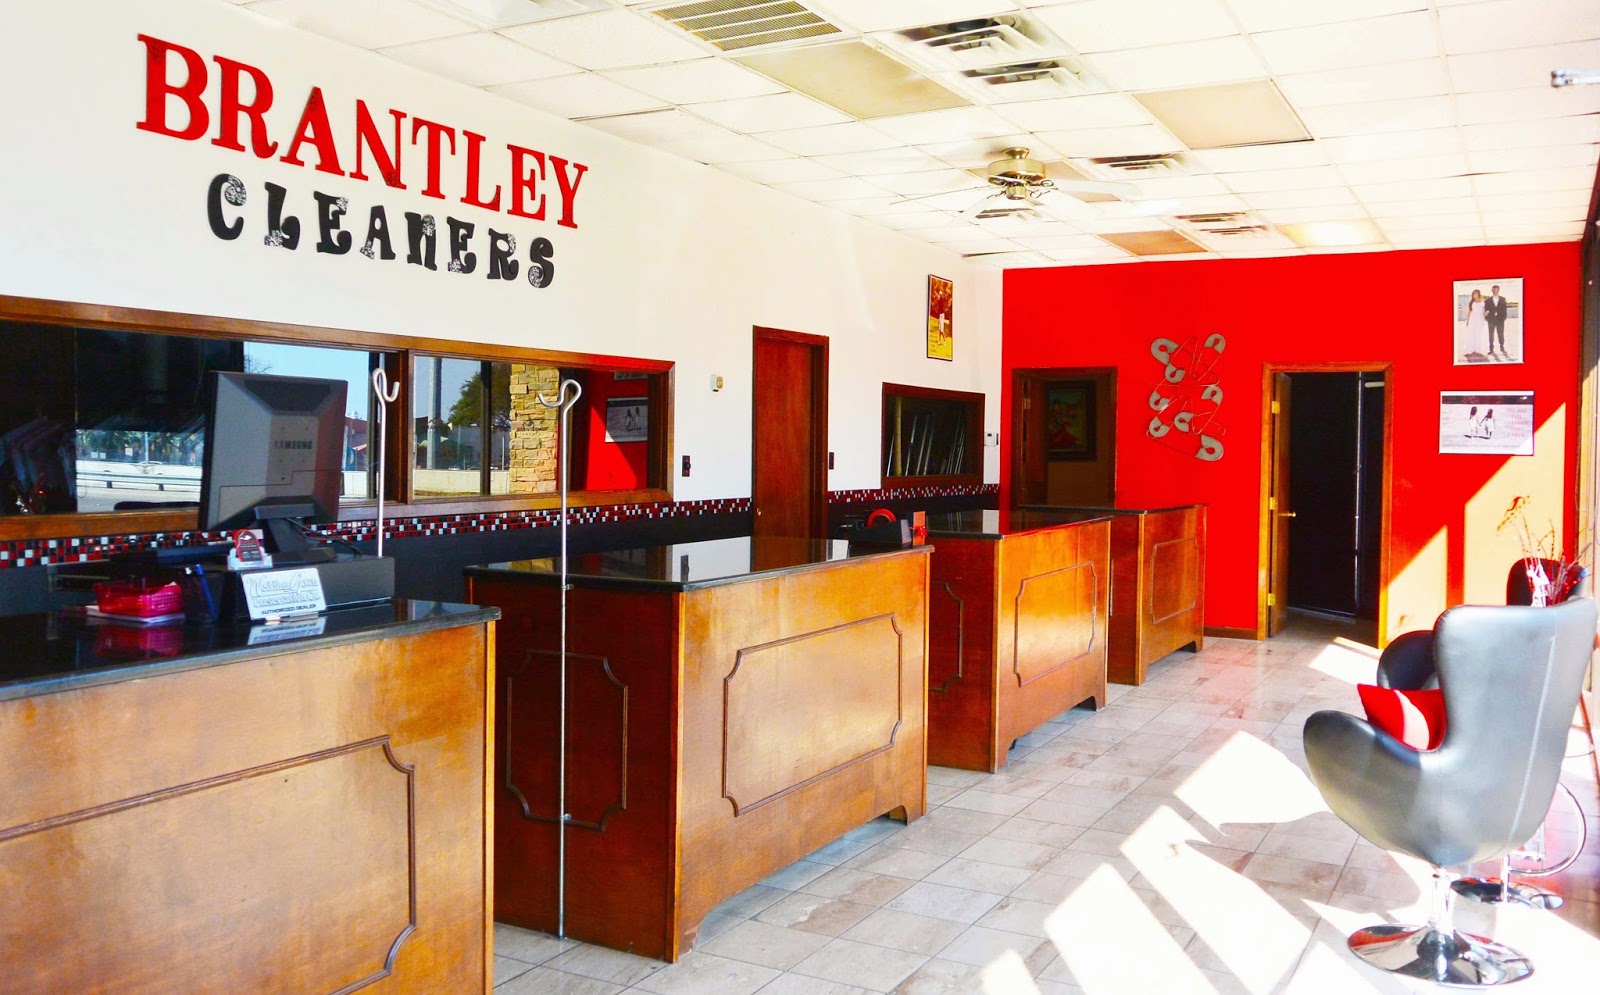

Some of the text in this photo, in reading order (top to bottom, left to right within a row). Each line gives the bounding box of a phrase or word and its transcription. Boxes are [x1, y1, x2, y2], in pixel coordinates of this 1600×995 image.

[136, 33, 588, 229] BRANTLEY
[207, 172, 555, 289] CLEANERS
[274, 440, 313, 449] SAMSUNG
[261, 606, 295, 614] AUTHORIZED
